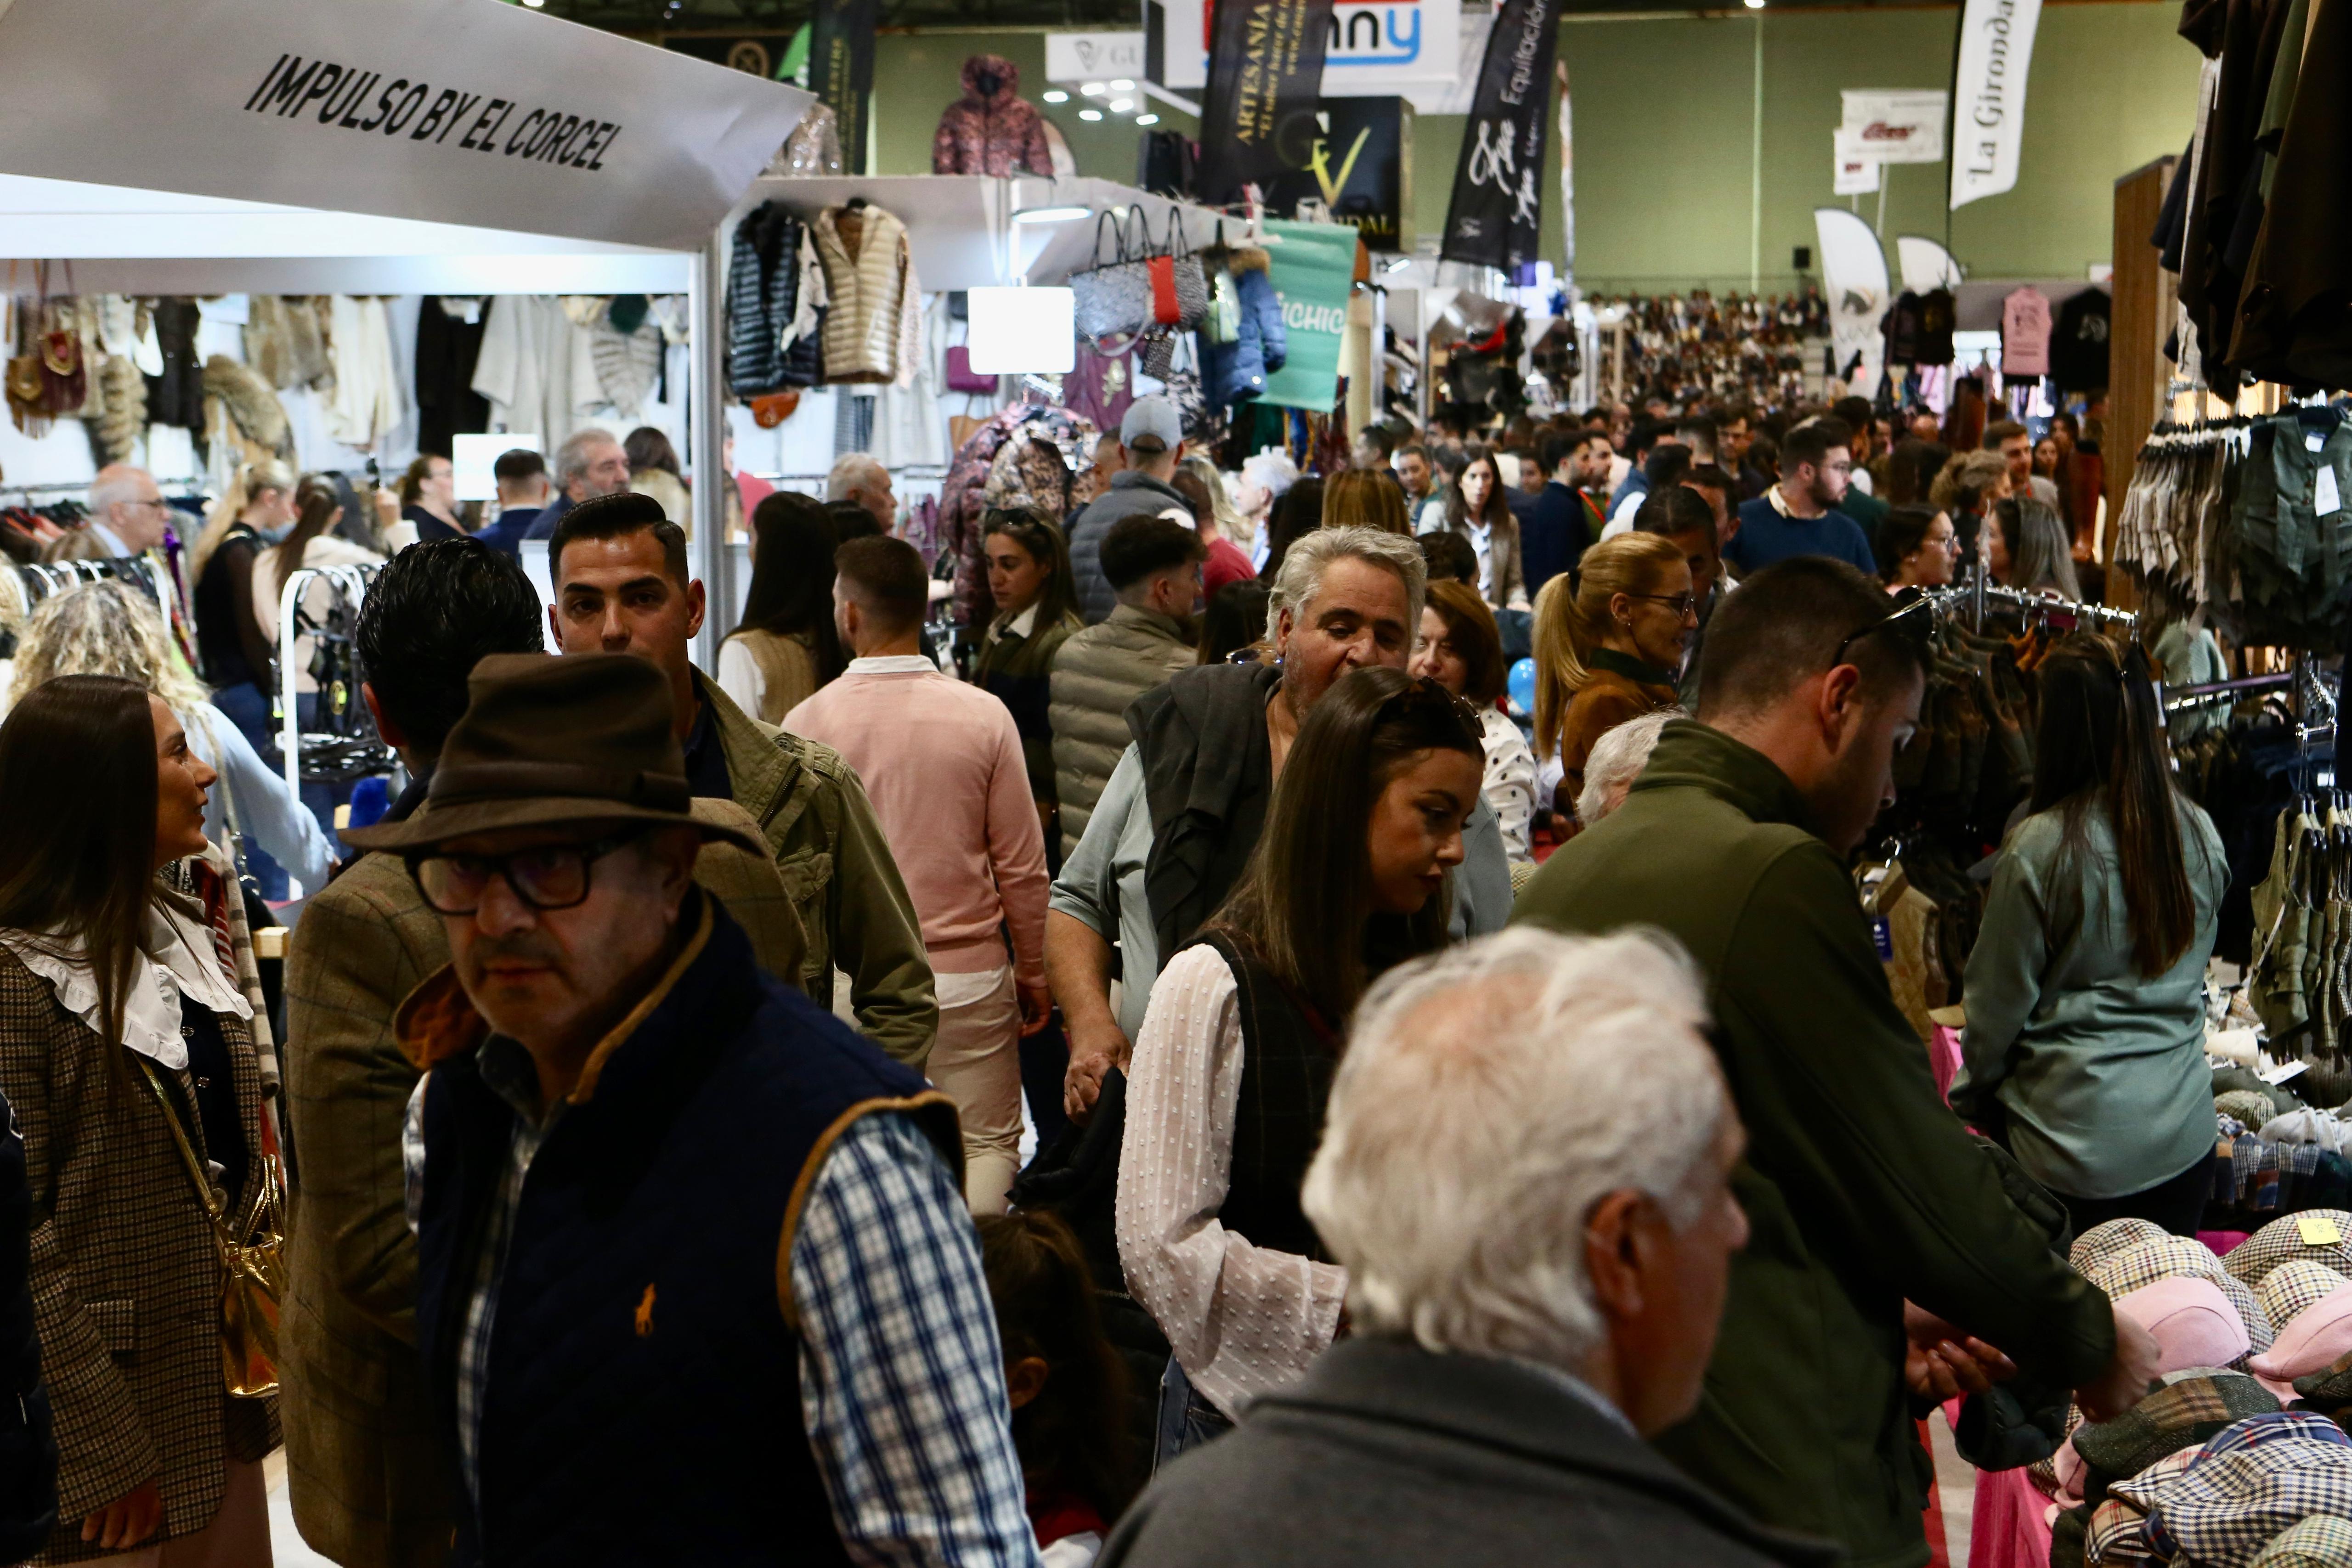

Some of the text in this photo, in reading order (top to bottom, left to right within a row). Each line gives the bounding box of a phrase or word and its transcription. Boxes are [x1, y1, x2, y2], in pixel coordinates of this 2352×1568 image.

[244, 54, 622, 171] IMPULSO BY EL CORCEL
[1967, 0, 2015, 185] La Gironda
